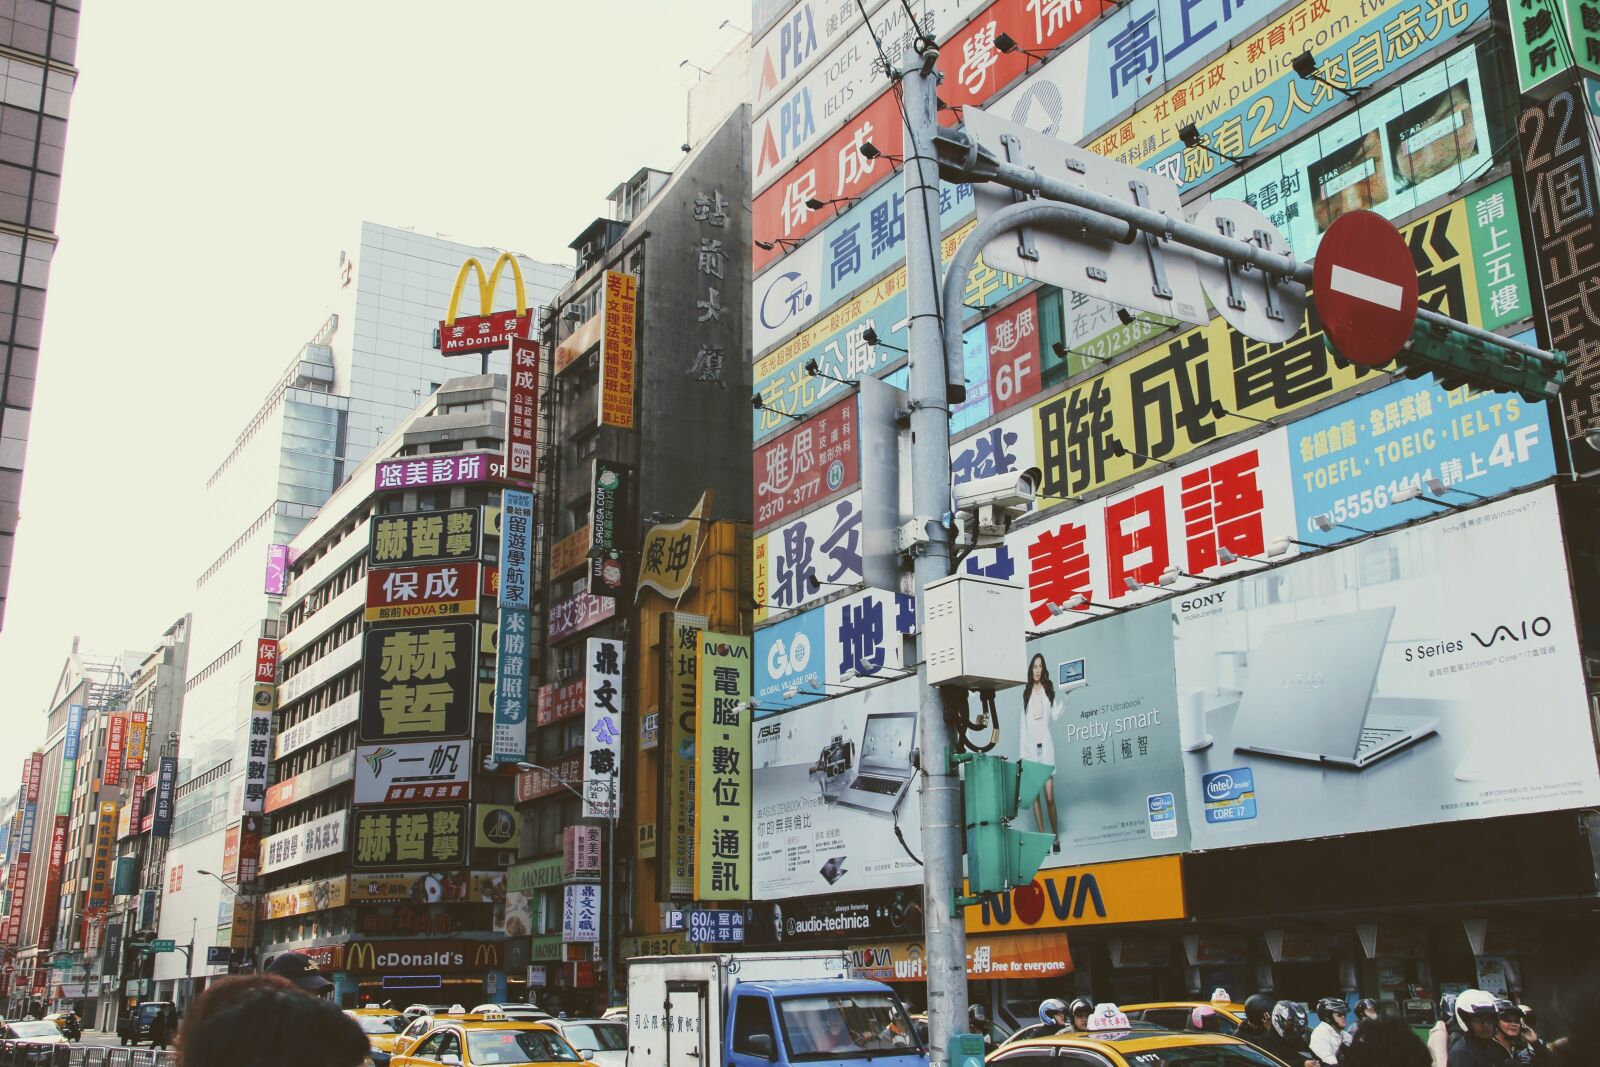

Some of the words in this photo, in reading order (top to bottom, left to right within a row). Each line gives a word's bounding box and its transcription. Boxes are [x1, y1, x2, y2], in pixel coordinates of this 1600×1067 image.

[824, 45, 861, 86] TOEFL
[823, 80, 854, 119] IELTS
[829, 191, 905, 290] 高點
[1475, 191, 1521, 318] 請上五樓
[685, 189, 730, 389] 站前大廈
[446, 332, 519, 349] McDonald's
[452, 318, 518, 338] 麥當勞
[514, 347, 535, 390] 保成
[995, 351, 1032, 401] 6F
[513, 447, 530, 456] NOVA
[513, 455, 530, 470] 9F
[1303, 456, 1362, 493] TOEFL
[1375, 427, 1437, 467] TOEIC
[1451, 398, 1521, 441] IELTS
[379, 455, 480, 488] 悠美診所
[505, 516, 528, 602] 留遊學航家
[643, 532, 692, 583] 燦坤
[382, 567, 459, 603] 保成
[1181, 590, 1227, 613] SONY
[704, 641, 749, 659] NOVA
[1405, 648, 1413, 662] S
[1417, 639, 1464, 659] Series
[1470, 616, 1552, 648] VAIO
[257, 644, 277, 678] 保成
[501, 612, 527, 721] 來勝證照考
[379, 629, 457, 736] 赫哲
[589, 641, 620, 778] 鼎文公職
[1067, 720, 1112, 743] Pretty,
[1115, 708, 1161, 734] smart
[1079, 707, 1098, 720] Aspire
[757, 722, 781, 739] ASUS
[246, 716, 269, 803] 赫哲數學
[398, 744, 461, 775] 一帆
[159, 763, 173, 819] 元照出版公司
[578, 885, 596, 932] 鼎文公職
[672, 911, 682, 926] P
[718, 912, 743, 926] 室內
[796, 913, 870, 932] audio-technica
[718, 927, 743, 940] 平面
[852, 947, 893, 968] NOVA
[992, 961, 1008, 972] Free
[1010, 961, 1022, 971] for
[1024, 960, 1065, 973] everyone
